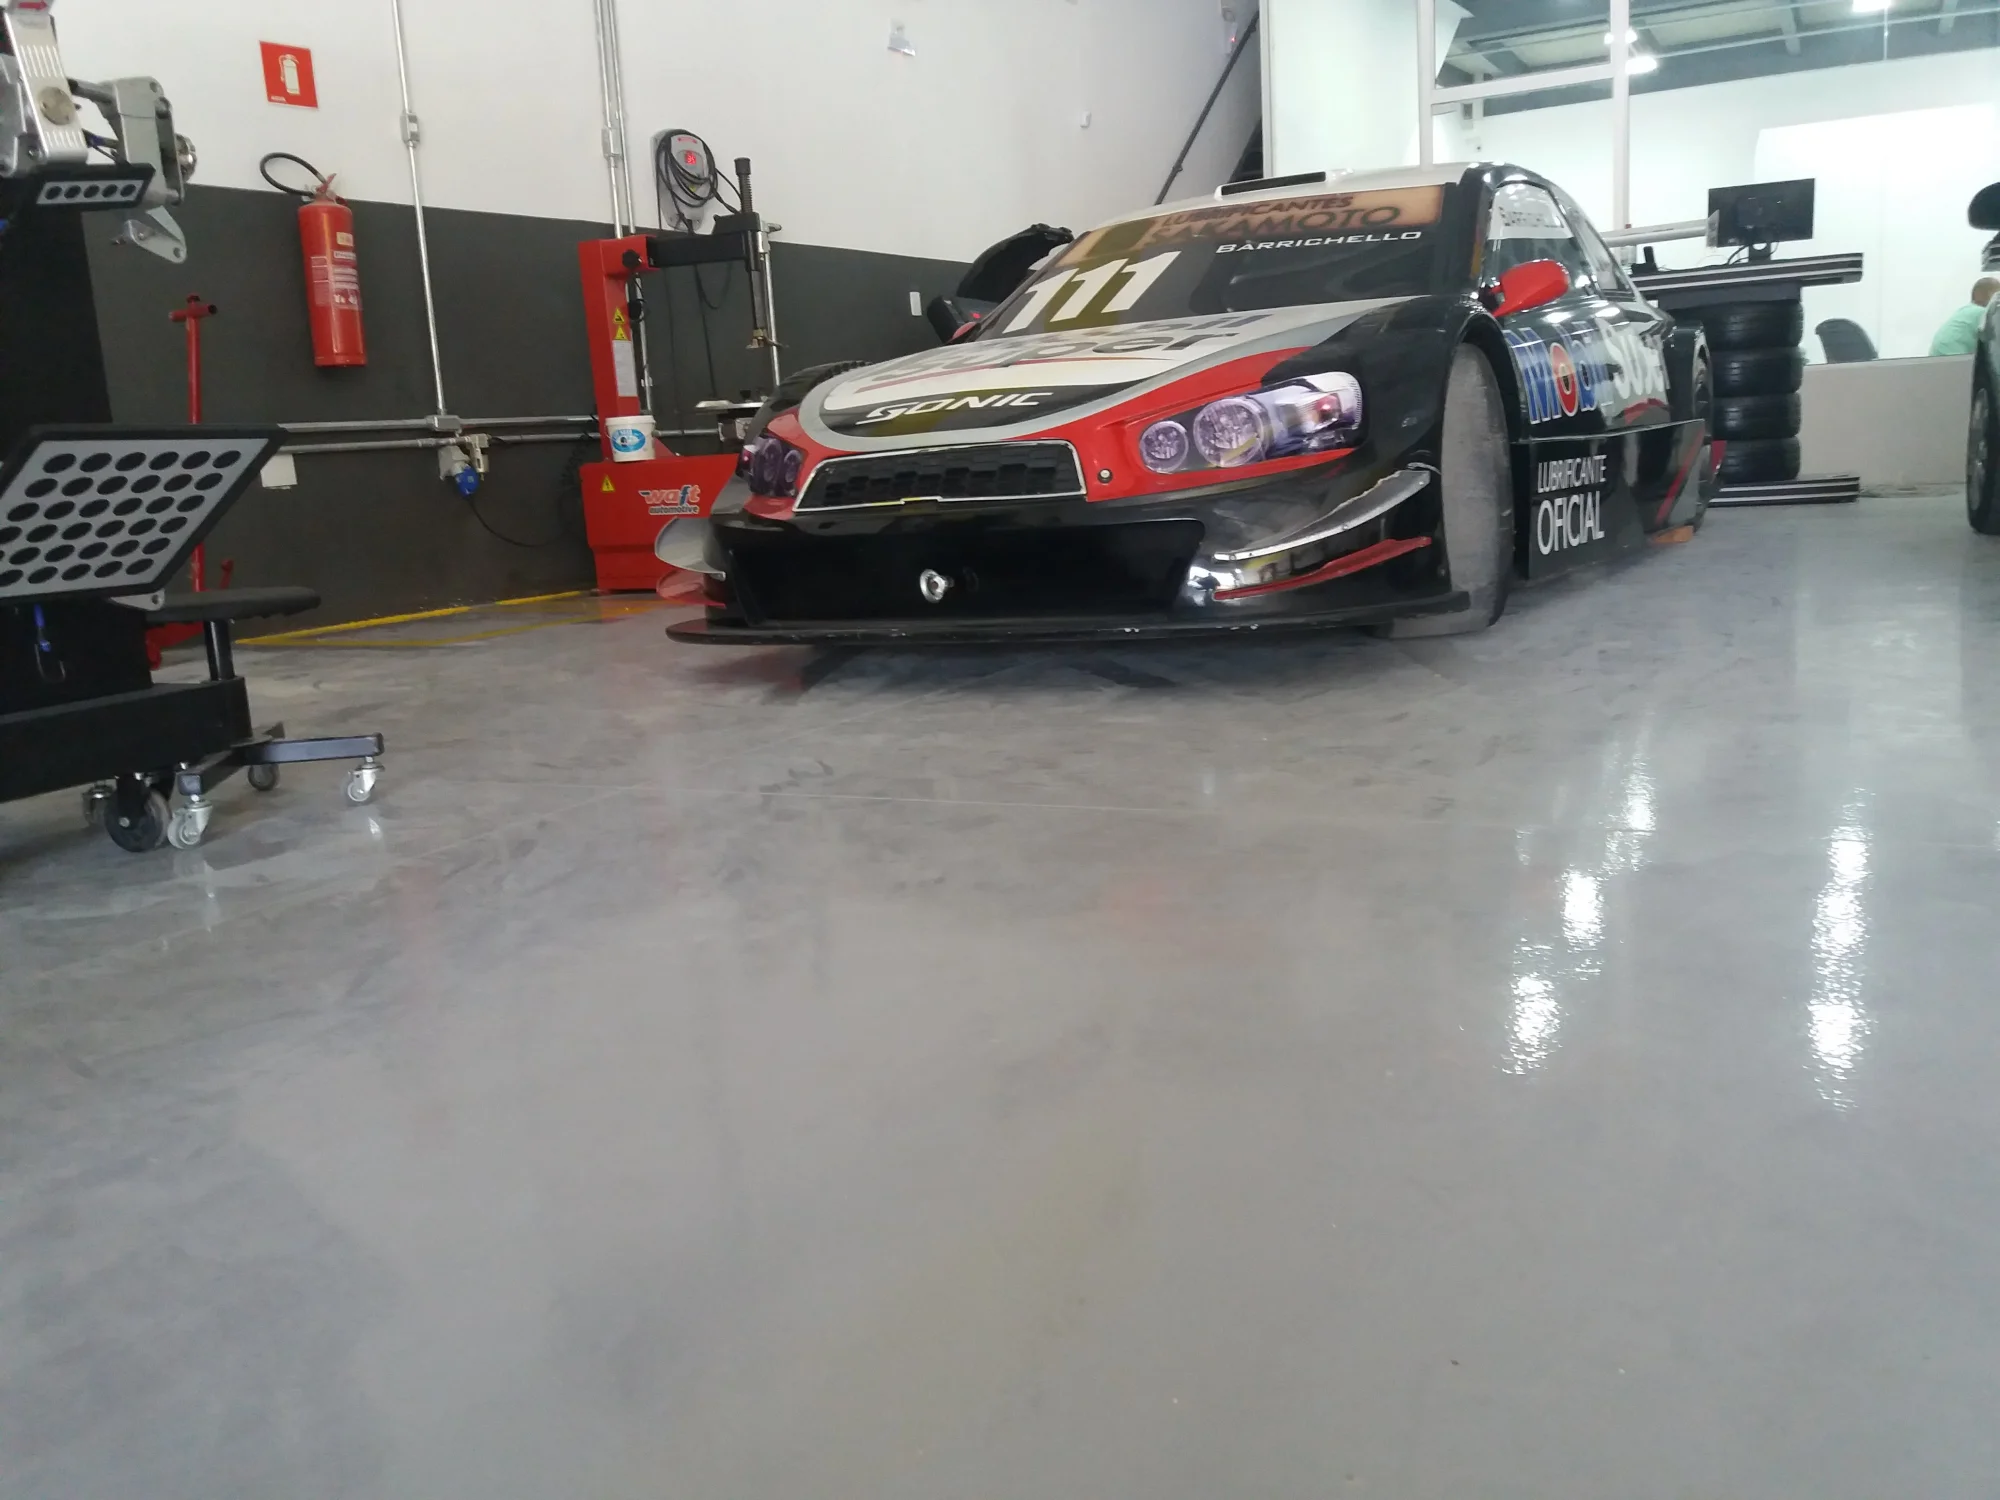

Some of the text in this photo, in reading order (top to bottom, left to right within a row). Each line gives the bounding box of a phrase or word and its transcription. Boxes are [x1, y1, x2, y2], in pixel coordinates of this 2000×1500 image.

[1215, 231, 1422, 254] BARRICHELLO
[1001, 250, 1183, 335] 111
[855, 392, 1054, 426] SONIC
[1537, 454, 1607, 494] LUBRIFICANTE
[639, 484, 701, 506] waft
[648, 505, 701, 516] automotive
[1537, 490, 1605, 555] OFICIAL
